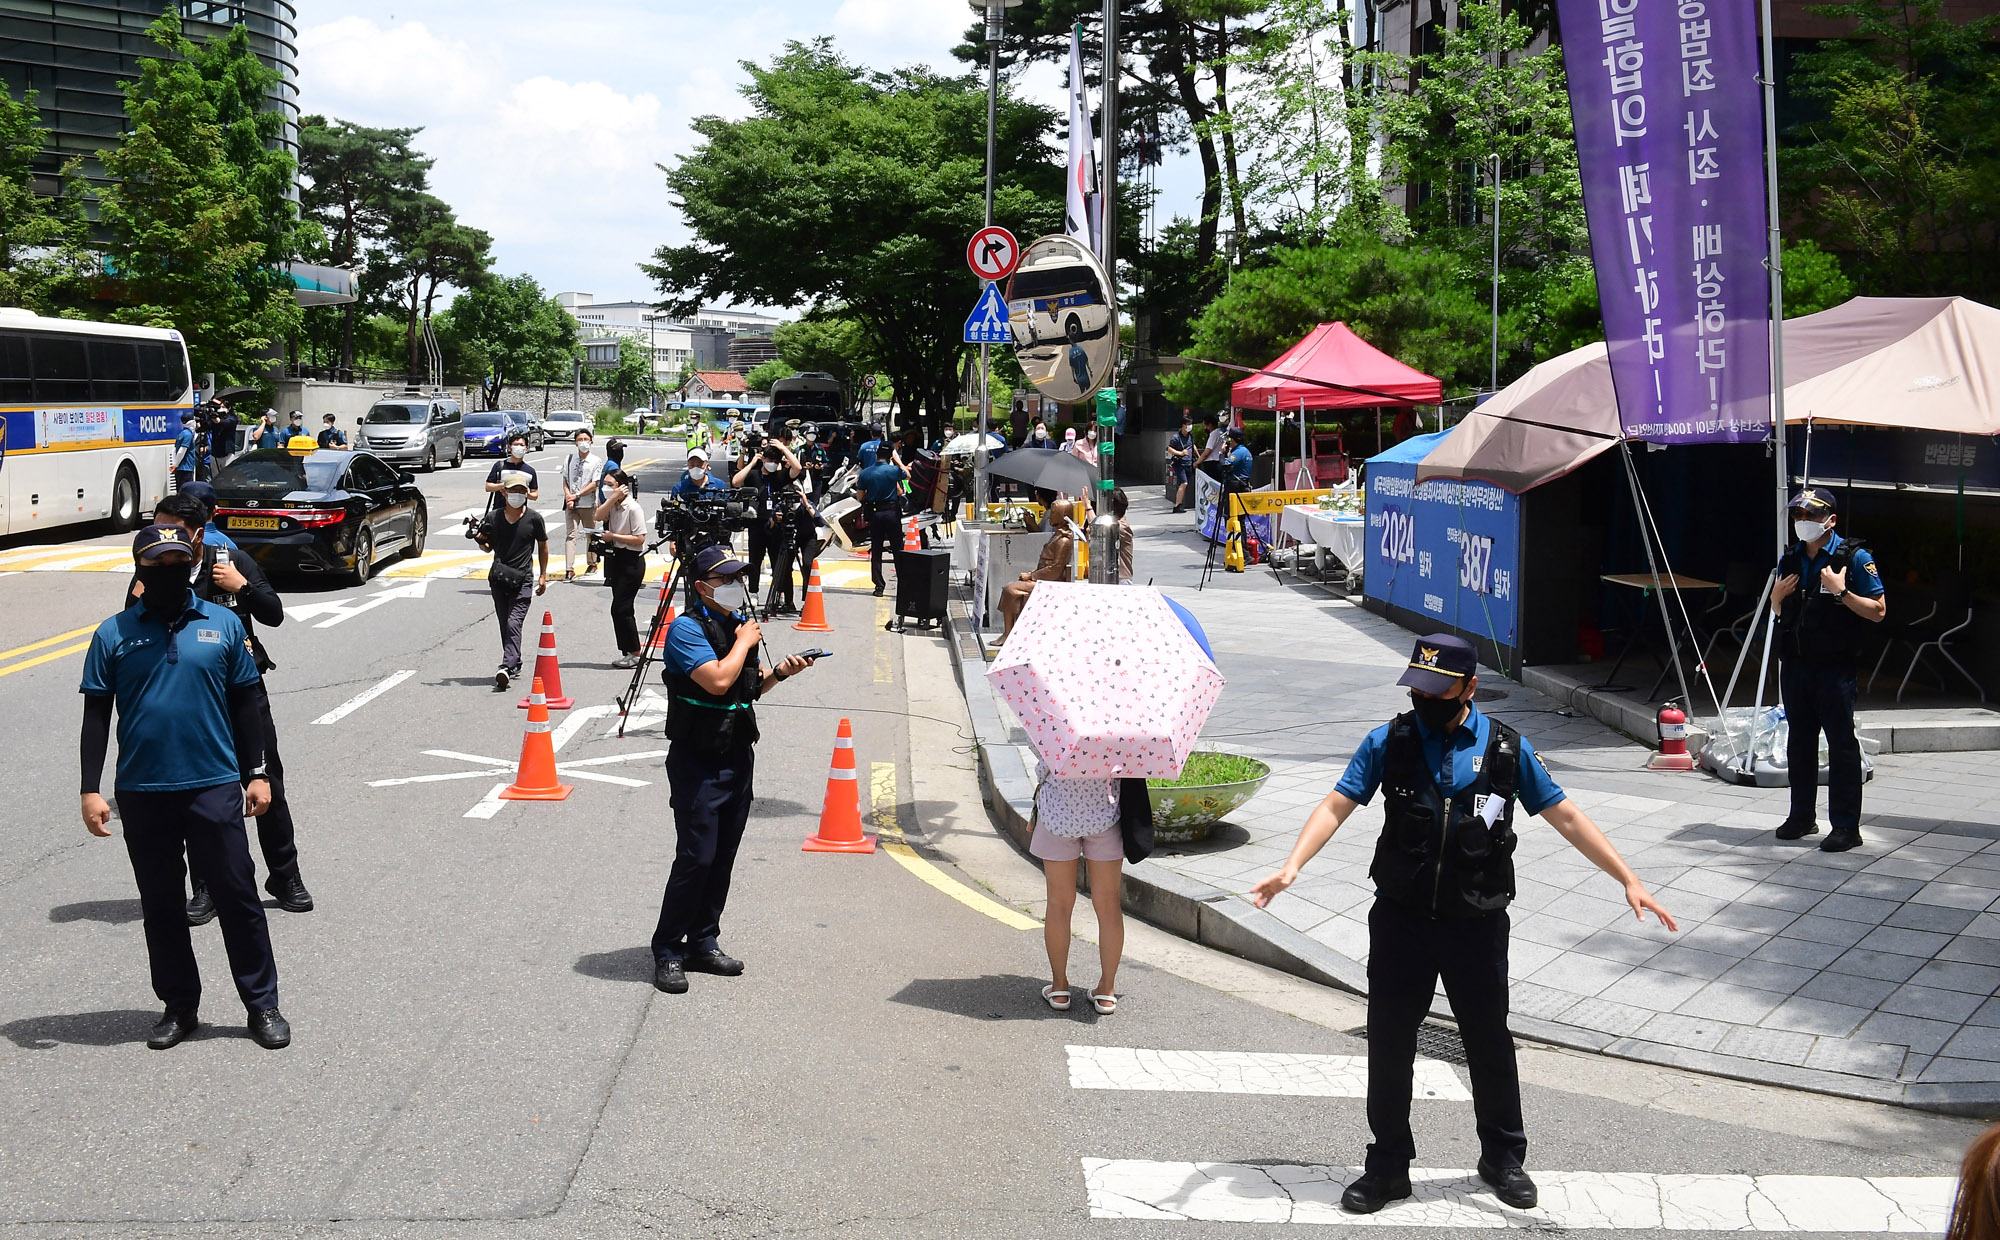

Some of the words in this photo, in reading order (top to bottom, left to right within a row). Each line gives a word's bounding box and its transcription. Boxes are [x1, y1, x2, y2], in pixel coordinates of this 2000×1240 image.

[971, 331, 1011, 340] 횡단보도
[53, 411, 69, 425] 사람이
[69, 411, 84, 424] 보이면
[85, 411, 95, 424] 일단
[139, 415, 167, 434] POLICE
[1924, 443, 1977, 467] 반일행동
[1268, 497, 1308, 507] POLICE
[254, 519, 276, 528] 5812
[1381, 510, 1415, 565] 2024
[1419, 550, 1432, 579] 일차
[1460, 531, 1491, 594] 387
[1494, 568, 1511, 601] 일차
